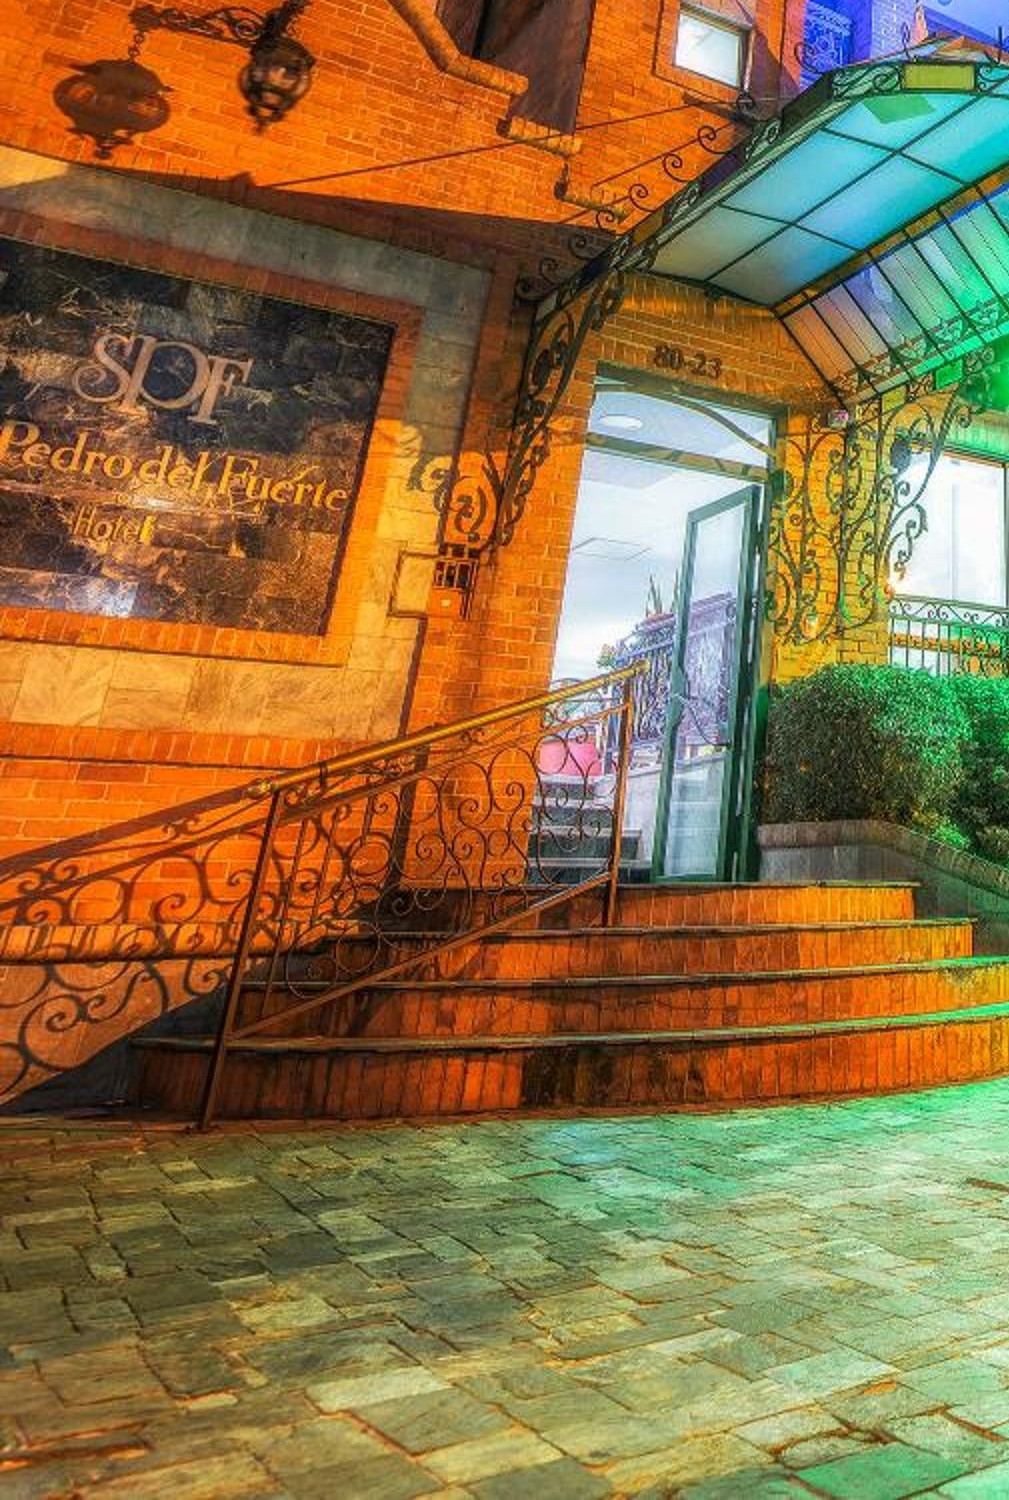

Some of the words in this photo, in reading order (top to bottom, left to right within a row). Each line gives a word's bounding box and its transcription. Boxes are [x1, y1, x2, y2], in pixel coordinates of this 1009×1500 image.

[0, 420, 133, 479] Pedro
[138, 445, 209, 496] del
[218, 455, 349, 511] Fuerte
[73, 505, 157, 545] Hotel
